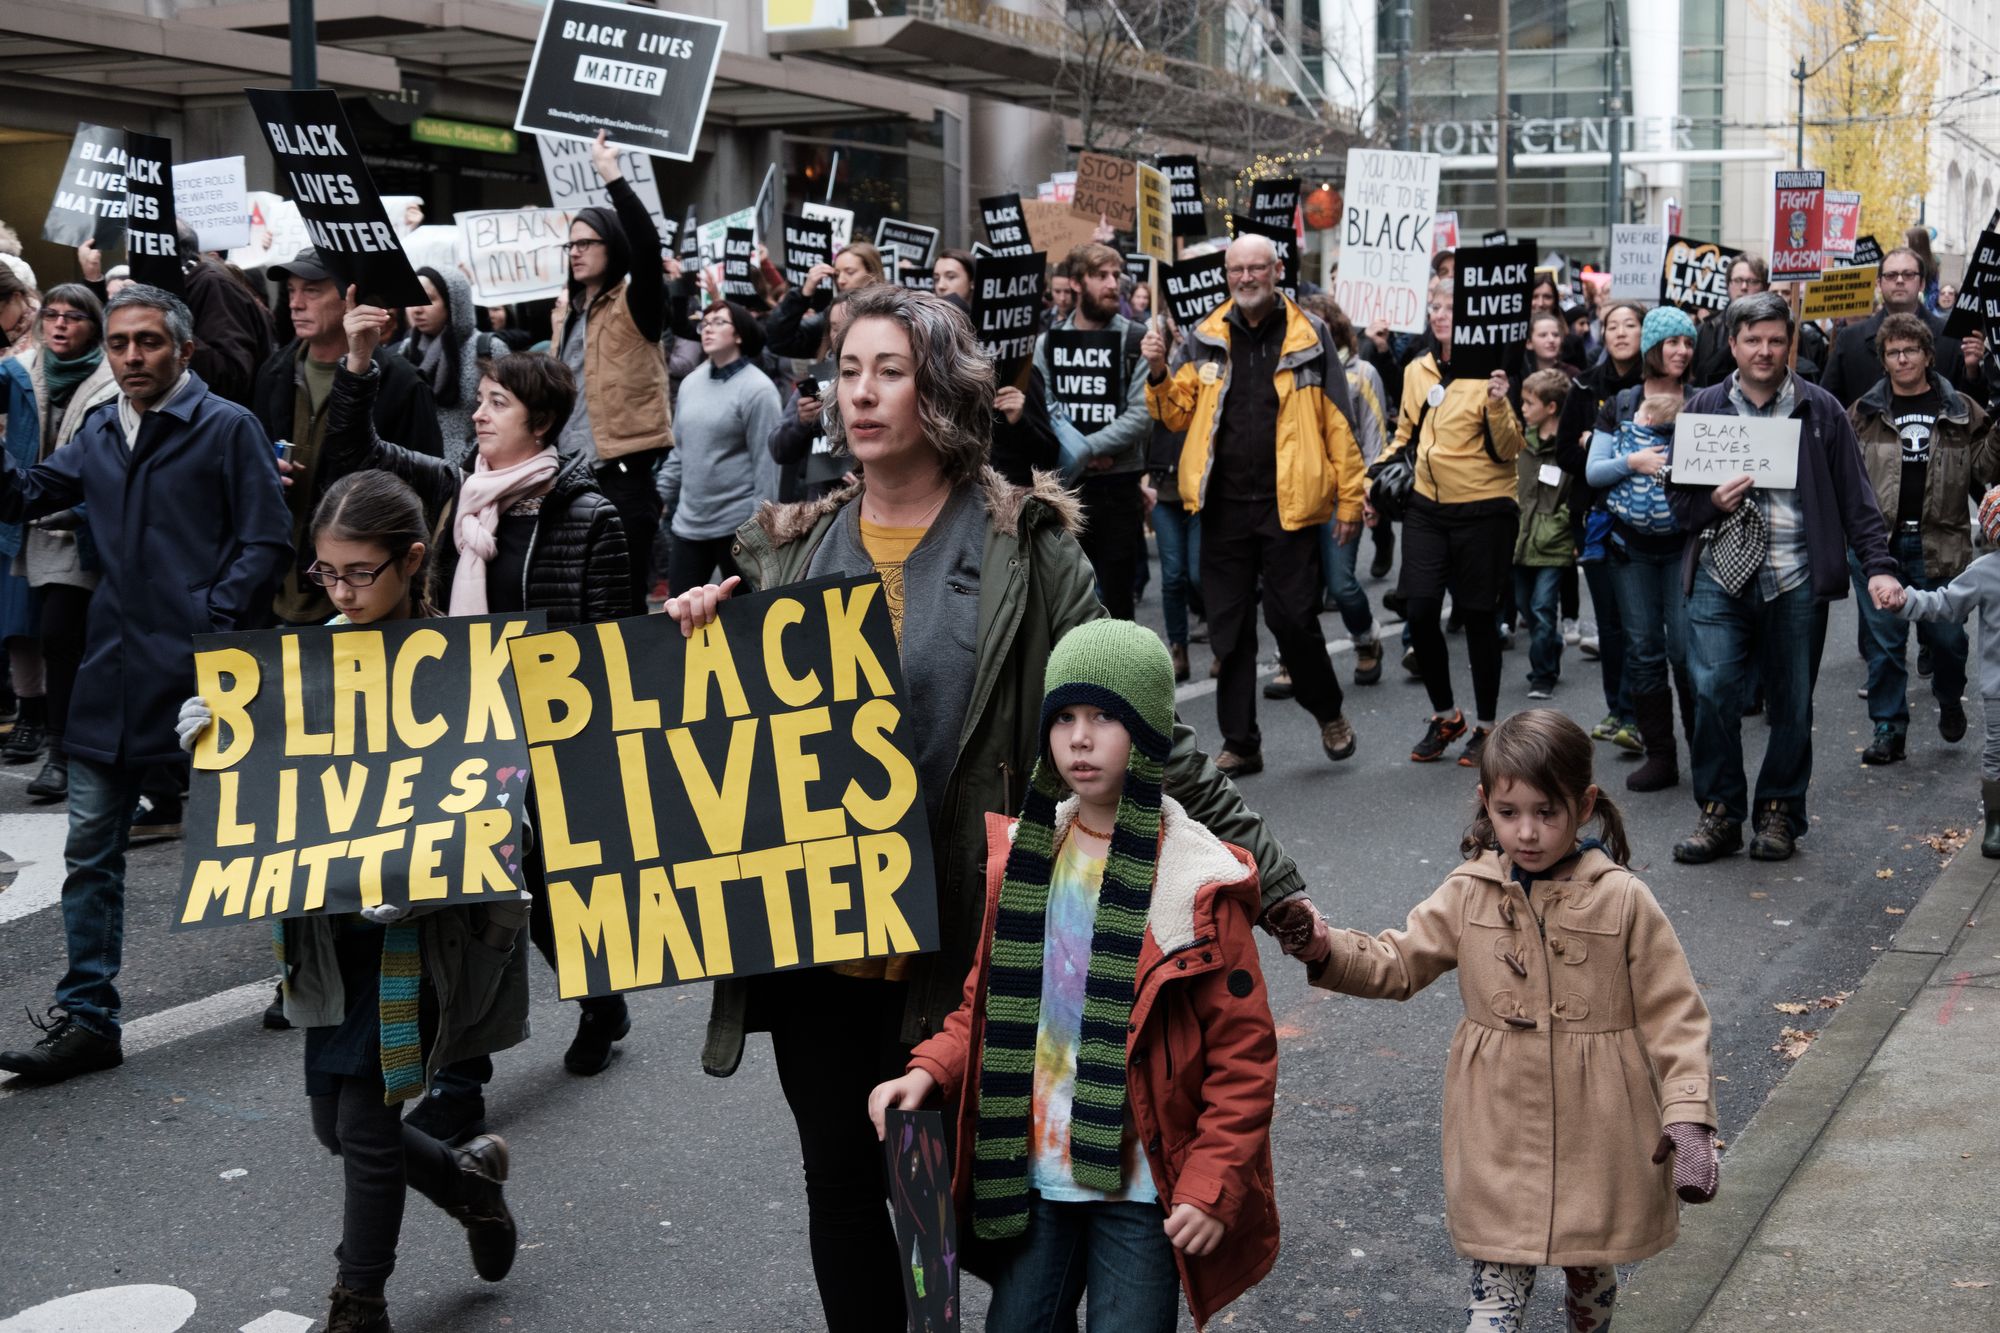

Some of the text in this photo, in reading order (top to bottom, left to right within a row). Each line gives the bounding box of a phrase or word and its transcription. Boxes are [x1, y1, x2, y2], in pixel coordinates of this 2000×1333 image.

[562, 20, 694, 60] BLACK LIVES
[584, 61, 657, 90] MATTER
[416, 119, 496, 146] Public Parking
[547, 107, 670, 138] ShowingUpForRacialJustice.org
[267, 122, 348, 156] BLACK
[1081, 156, 1135, 183] STOP
[1360, 152, 1385, 179] YOU
[204, 174, 236, 187] ROLLS
[289, 171, 360, 205] LIVES
[191, 189, 223, 202] WATER
[1073, 190, 1136, 223] RACISM
[1170, 201, 1203, 214] ATTER
[1255, 193, 1295, 210] BLACK
[1357, 181, 1430, 211] HAVE TO BE
[1780, 190, 1820, 211] FIGHT
[984, 206, 1020, 225] BLACK
[303, 216, 398, 253] MATTER
[474, 211, 560, 248] BLACK
[786, 227, 827, 249] BLACK
[990, 225, 1022, 244] LIVES
[1347, 207, 1430, 253] BLACK
[725, 260, 748, 277] LIVES
[1357, 250, 1412, 283] TO BE
[1620, 252, 1653, 265] STILL
[1673, 244, 1732, 274] BLAC
[1772, 250, 1821, 271] RACISM
[982, 273, 1038, 300] BLACK
[1166, 267, 1226, 295] BLACK
[1463, 263, 1527, 287] BLACK
[1614, 272, 1648, 285] HERE
[1670, 264, 1728, 295] LIVE
[1844, 281, 1871, 290] CHURCH
[1467, 294, 1522, 316] LIVES
[1665, 284, 1730, 311] MATTE
[1805, 304, 1825, 314] BLACK
[1845, 300, 1869, 310] MATTER
[983, 305, 1033, 331] LIVES
[1454, 321, 1528, 345] MATTER
[1053, 347, 1112, 368] BLACK
[1056, 375, 1107, 395] LIVES
[1694, 423, 1750, 438] BLACK
[1685, 457, 1771, 472] MATTER
[507, 582, 896, 744] BLACK
[194, 620, 528, 770] BLACK
[529, 699, 918, 872] LIVES
[216, 757, 489, 848] LIVES
[180, 808, 517, 924] MATTER
[547, 831, 920, 999] MATTER
